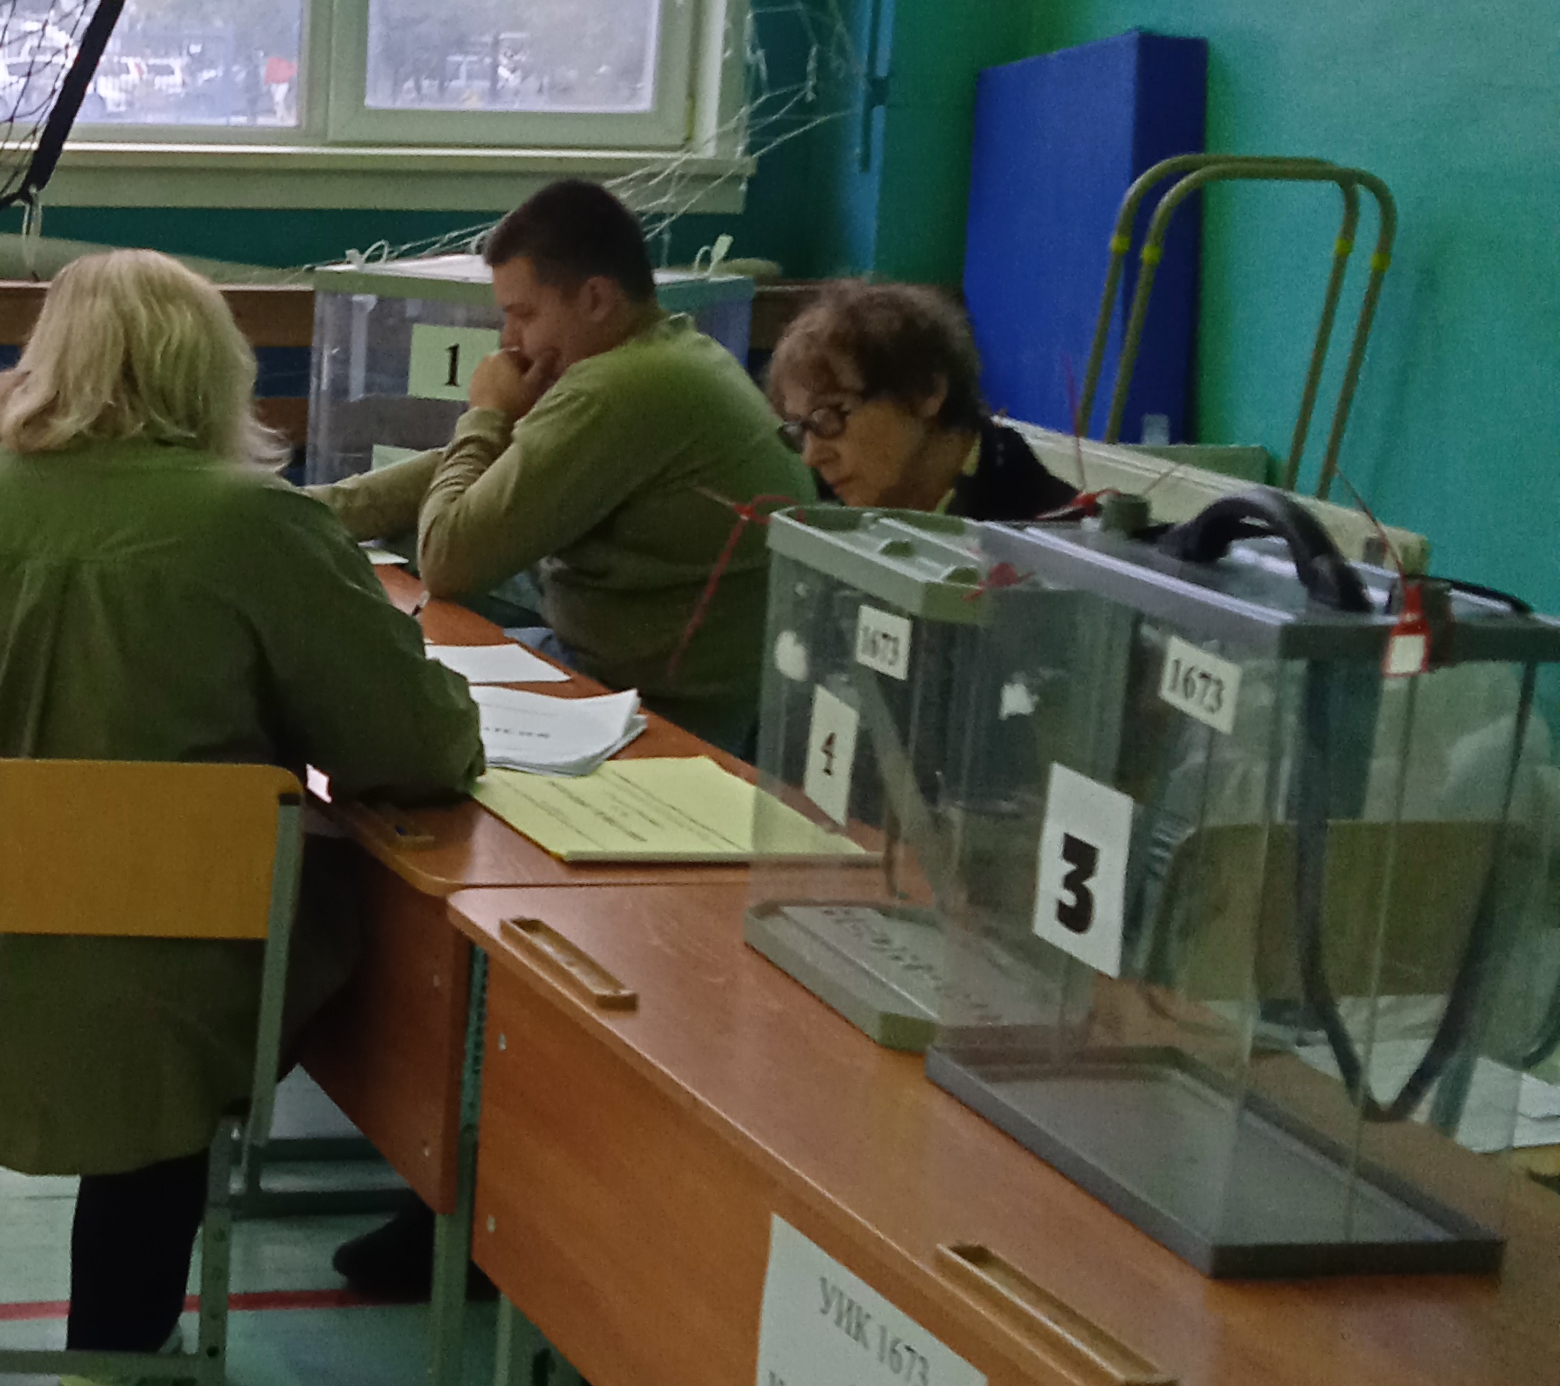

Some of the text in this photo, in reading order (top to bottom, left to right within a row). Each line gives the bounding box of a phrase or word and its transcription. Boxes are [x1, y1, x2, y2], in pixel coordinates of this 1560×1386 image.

[444, 343, 460, 387] 1
[1170, 659, 1224, 714] 1673
[821, 732, 836, 777] 4
[1057, 832, 1100, 934] 3
[820, 1276, 871, 1350] УИК
